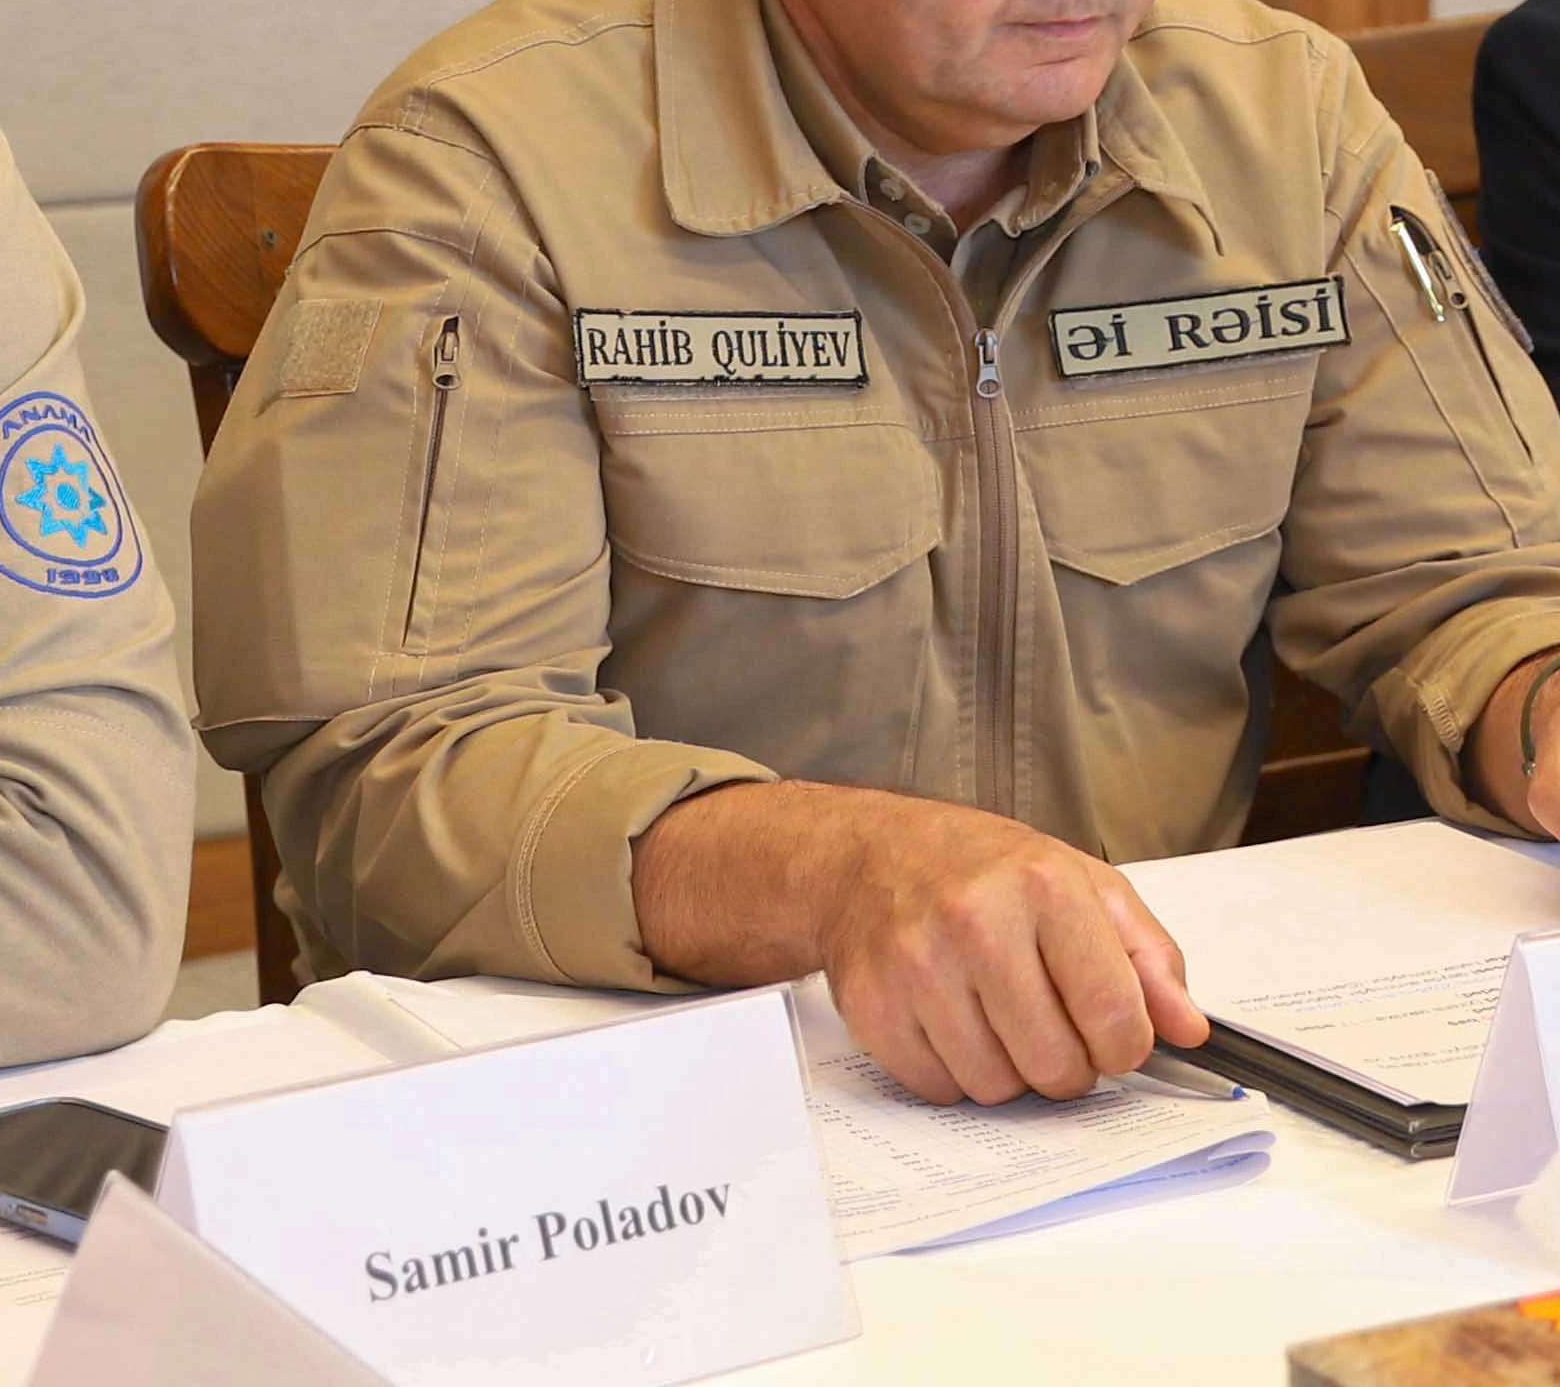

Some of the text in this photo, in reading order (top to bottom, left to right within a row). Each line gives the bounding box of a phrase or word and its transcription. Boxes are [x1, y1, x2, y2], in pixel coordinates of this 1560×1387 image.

[587, 319, 852, 376] RAHİB QULİYEV
[364, 1182, 732, 1303] Samir Poladov
